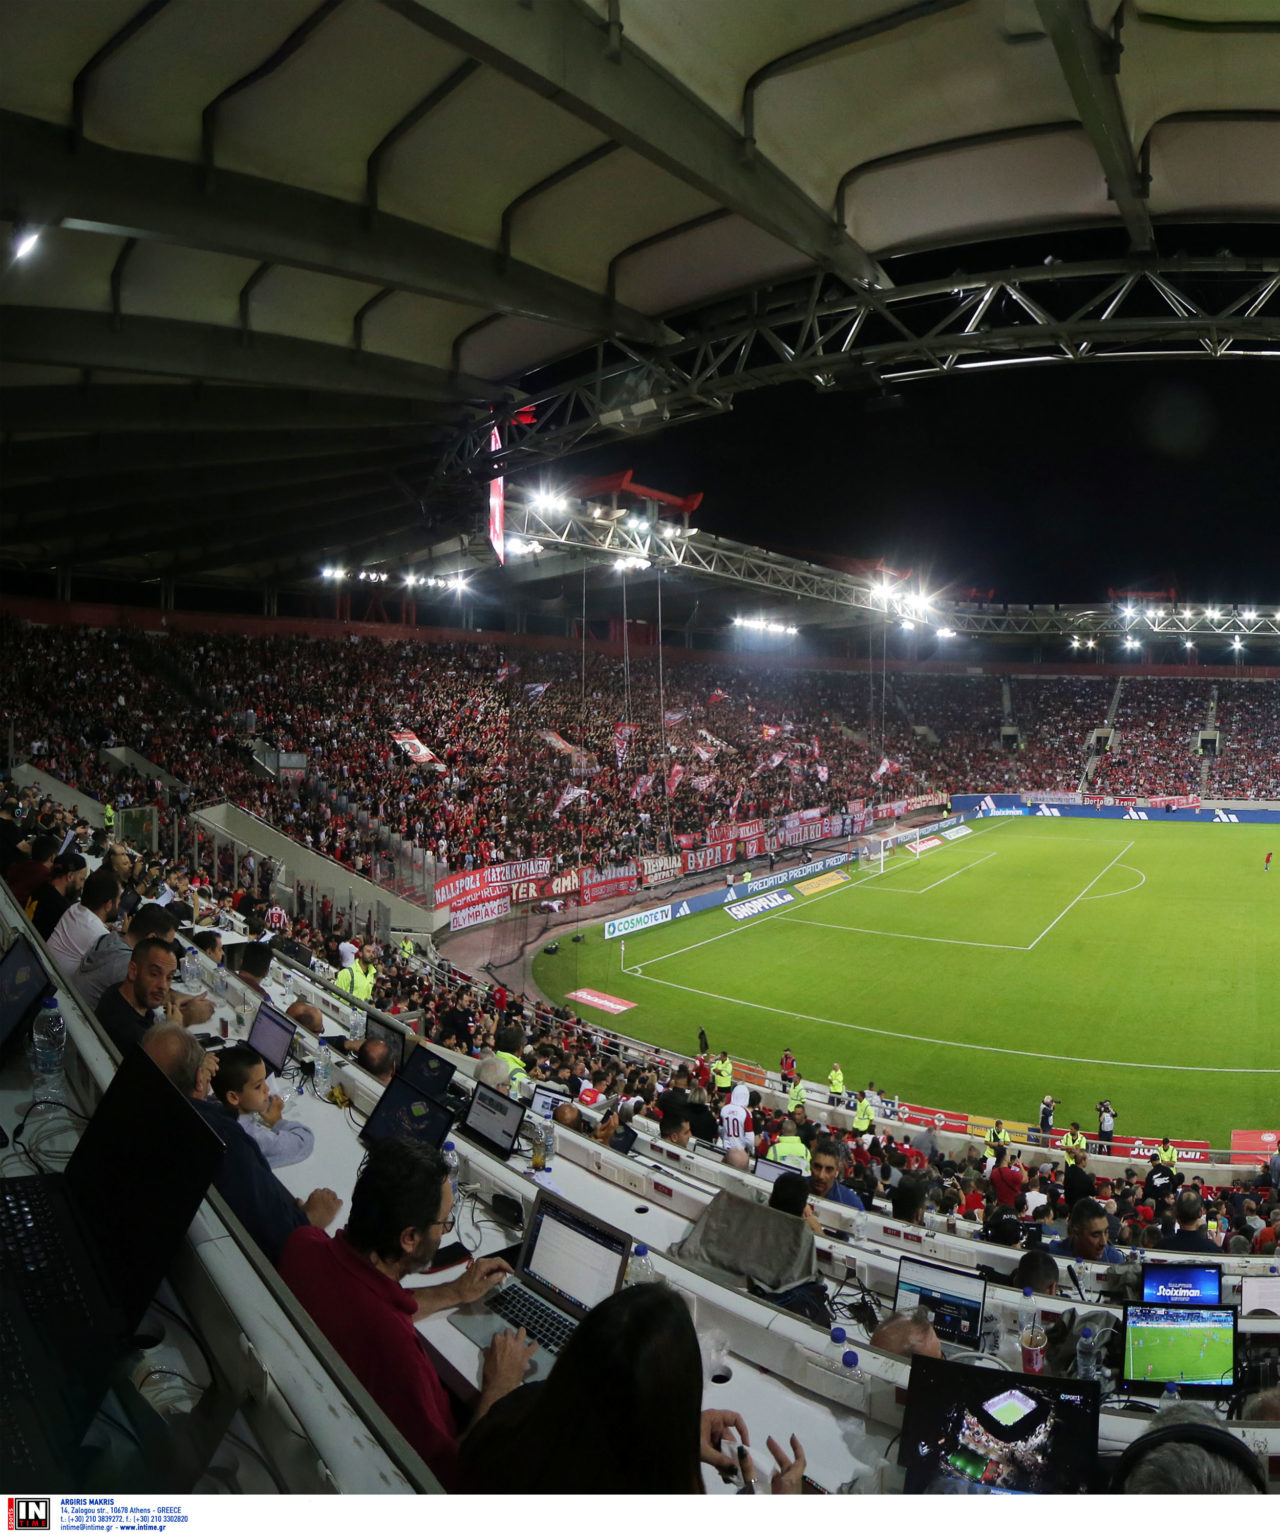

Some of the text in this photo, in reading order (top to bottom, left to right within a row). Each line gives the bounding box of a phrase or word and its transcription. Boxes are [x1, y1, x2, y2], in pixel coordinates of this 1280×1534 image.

[726, 842, 734, 861] 7
[748, 871, 788, 893] PREDATOR
[789, 861, 824, 880] PREDATOR
[452, 901, 510, 929] OLYMPIAKOS
[617, 908, 671, 932] COSMOTE TV
[725, 1117, 740, 1138] 10
